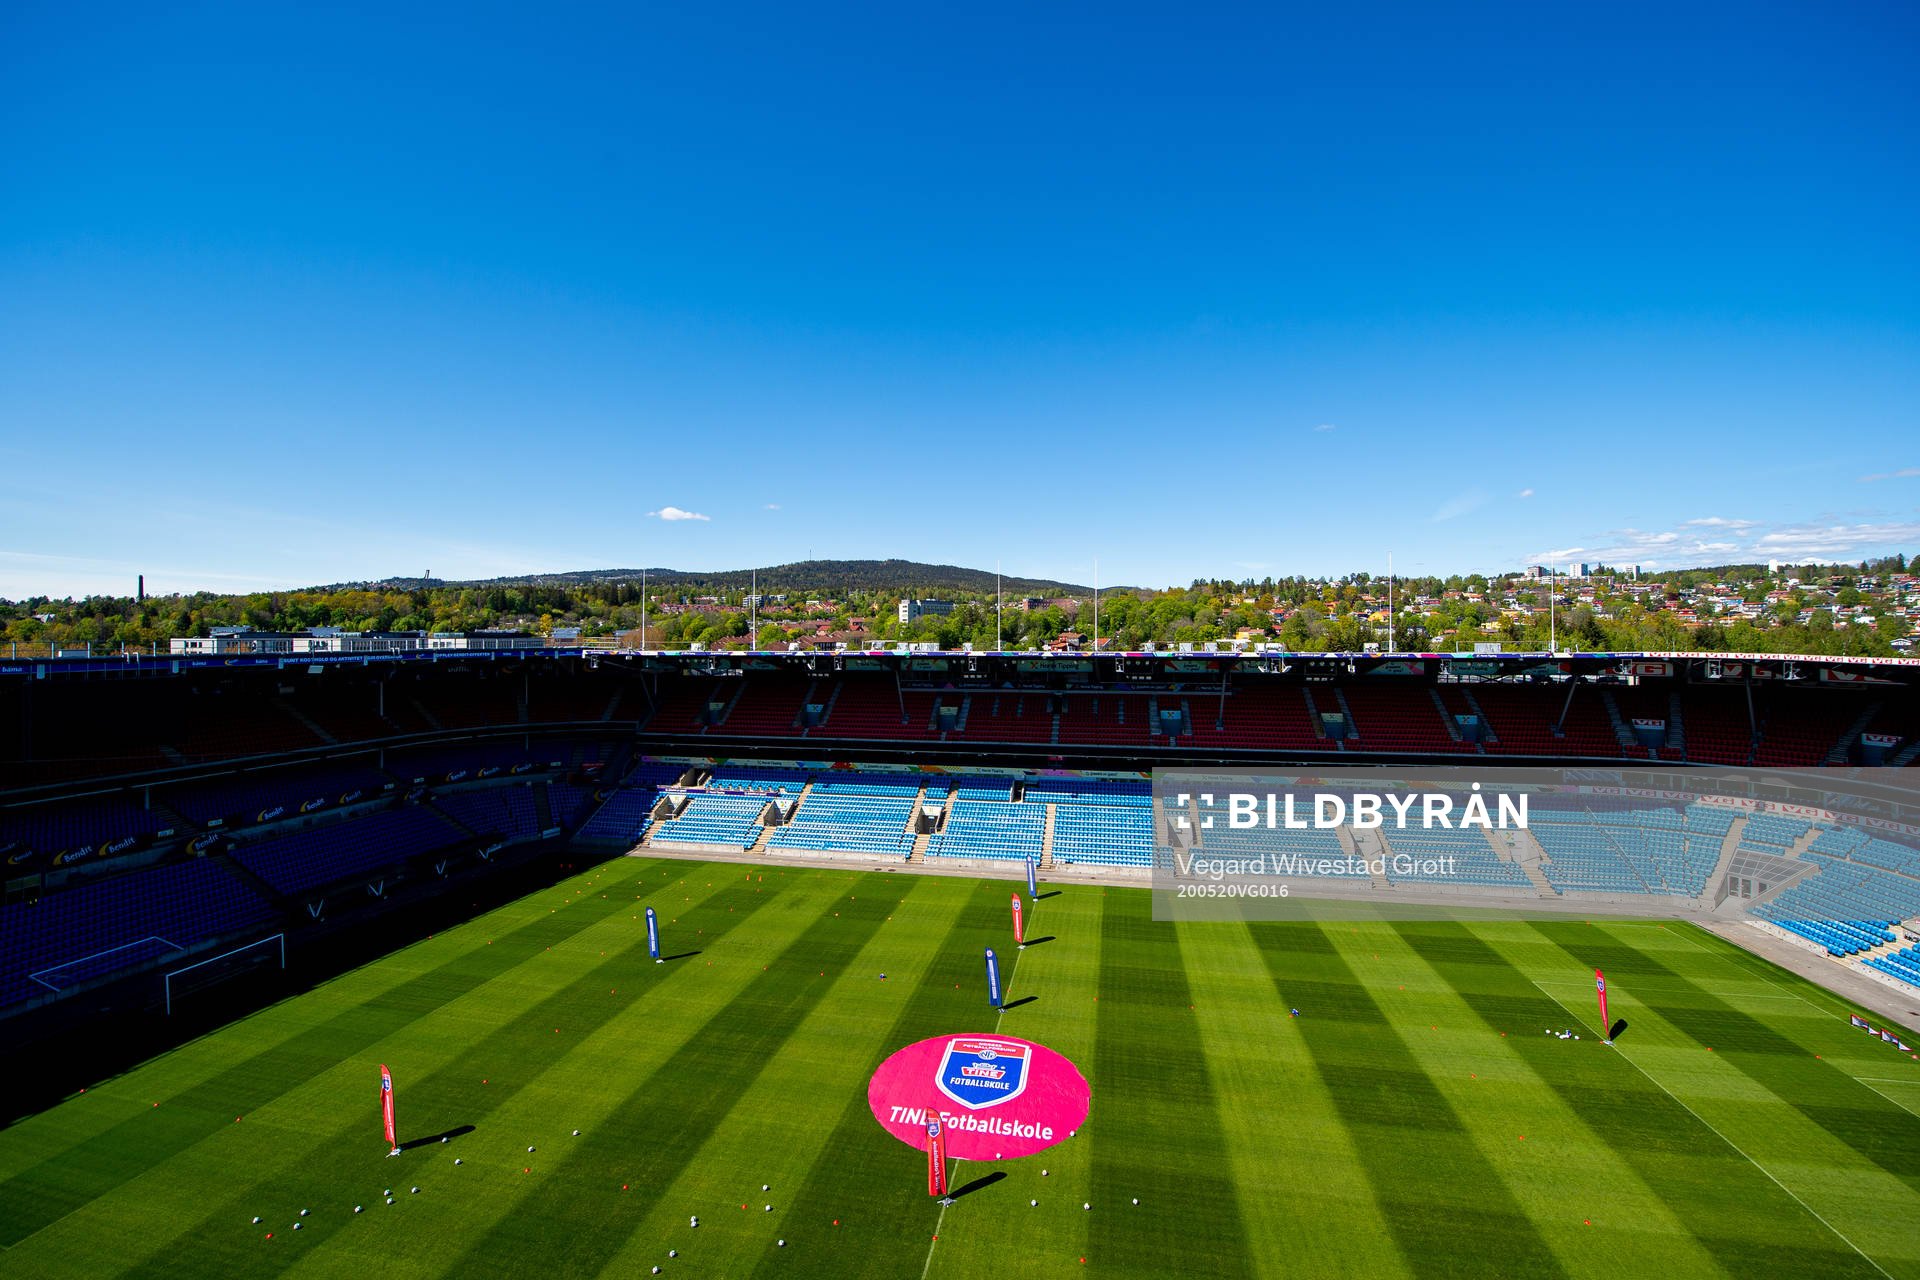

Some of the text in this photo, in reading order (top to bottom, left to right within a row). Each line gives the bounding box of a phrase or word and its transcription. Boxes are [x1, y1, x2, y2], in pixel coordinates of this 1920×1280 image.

[1701, 795, 1735, 805] VG
[1782, 804, 1818, 816] VG
[108, 835, 136, 855] Bendit
[63, 844, 94, 864] Bendit
[966, 1068, 999, 1078] TINE
[950, 1077, 1010, 1090] FOTBALLSKOLE
[941, 1112, 1053, 1140] Fotballskole
